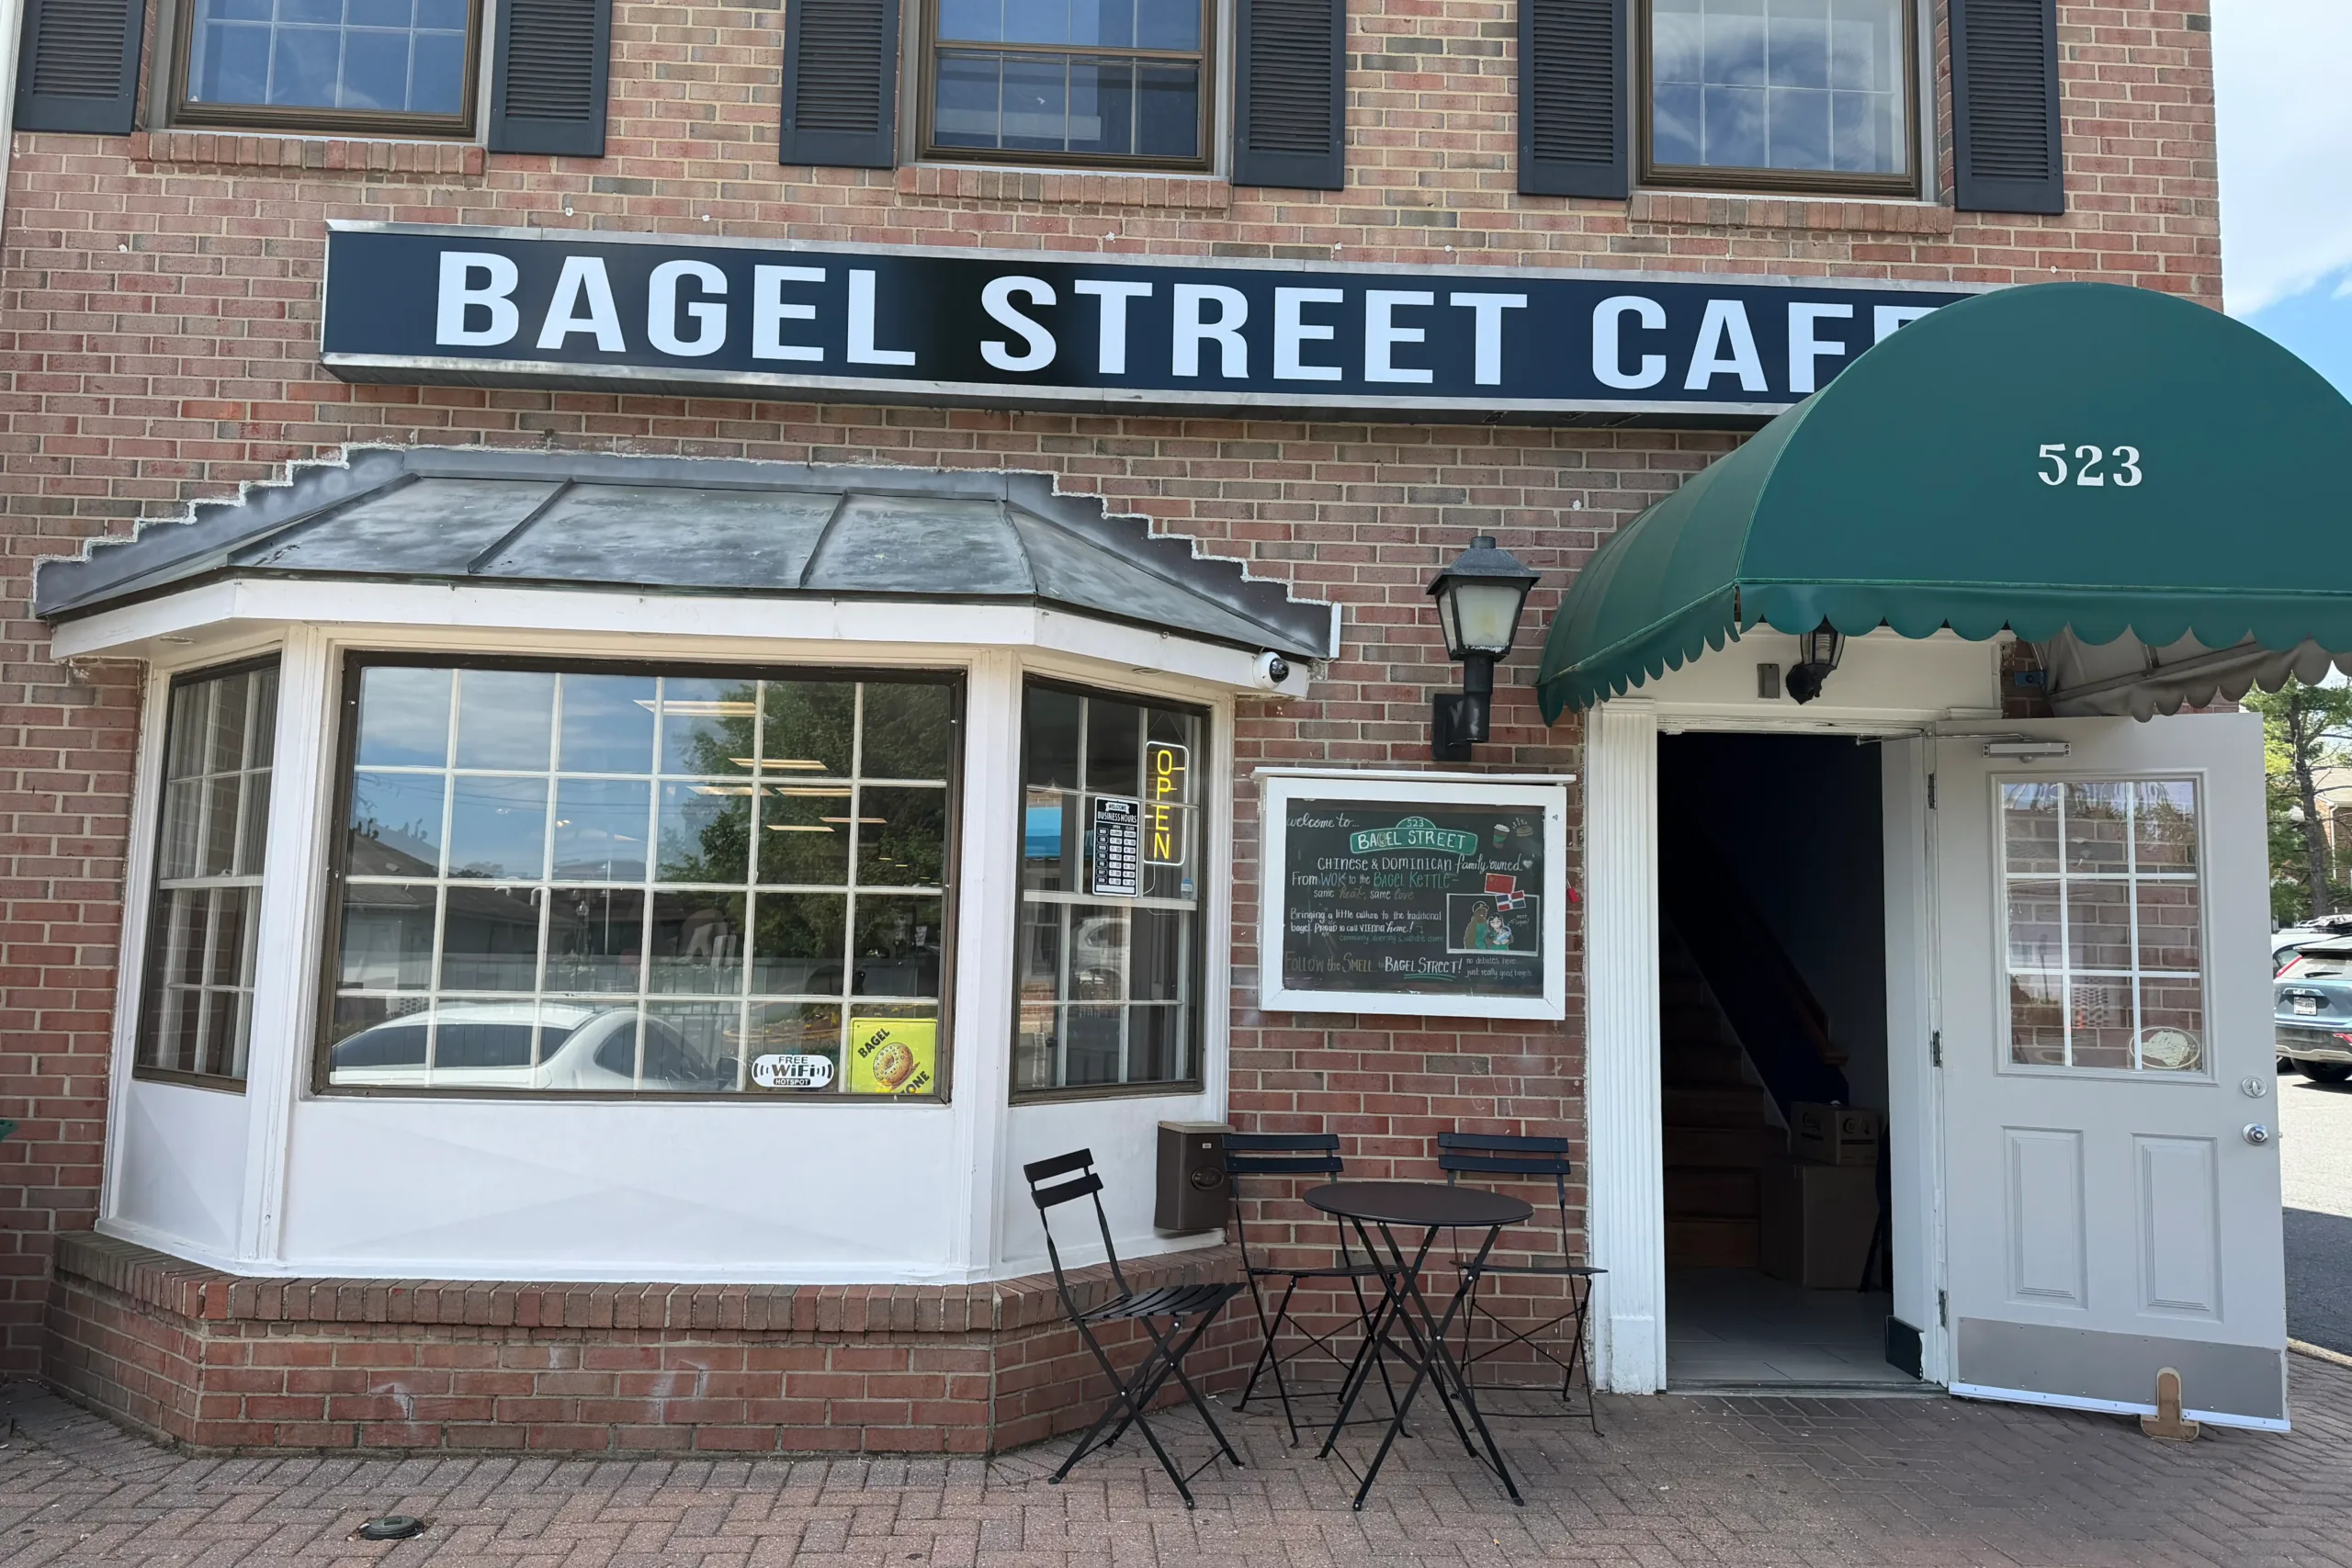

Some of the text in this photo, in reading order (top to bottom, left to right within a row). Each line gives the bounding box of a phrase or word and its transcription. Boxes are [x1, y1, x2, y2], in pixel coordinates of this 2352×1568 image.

[436, 251, 916, 367] BAGEL
[979, 274, 1528, 387] STREET
[2038, 444, 2143, 487] 523
[1153, 750, 1173, 860] OPEN
[1097, 811, 1137, 824] BUSINESS HOURS
[1286, 812, 1335, 828] welcome
[1406, 818, 1425, 828] 523
[1357, 829, 1466, 850] BAGEL STREET
[1371, 858, 1379, 871] &
[1454, 853, 1490, 874] family
[1488, 853, 1523, 872] owned
[1292, 871, 1318, 886] From
[1320, 872, 1347, 888] WOK
[1349, 874, 1357, 885] to
[1359, 874, 1371, 885] the
[1313, 889, 1335, 898] same
[1370, 888, 1391, 899] same
[1394, 887, 1415, 900] love
[1290, 907, 1442, 924] Bringing a little culture to the traditional
[1339, 924, 1346, 932] to
[1346, 923, 1359, 932] call
[1385, 920, 1414, 933] home!
[1285, 951, 1324, 973] FOLLOW
[1326, 955, 1341, 972] the
[1341, 952, 1372, 973] SMELL
[1385, 955, 1418, 973] BAGEL
[1476, 956, 1499, 964] debates
[1464, 967, 1479, 978] just
[1481, 967, 1498, 979] really
[1499, 969, 1513, 980] good
[857, 1027, 890, 1059] BAGEL
[778, 1055, 808, 1065] FREE
[772, 1064, 816, 1077] WiFi
[900, 1070, 931, 1094] ONE
